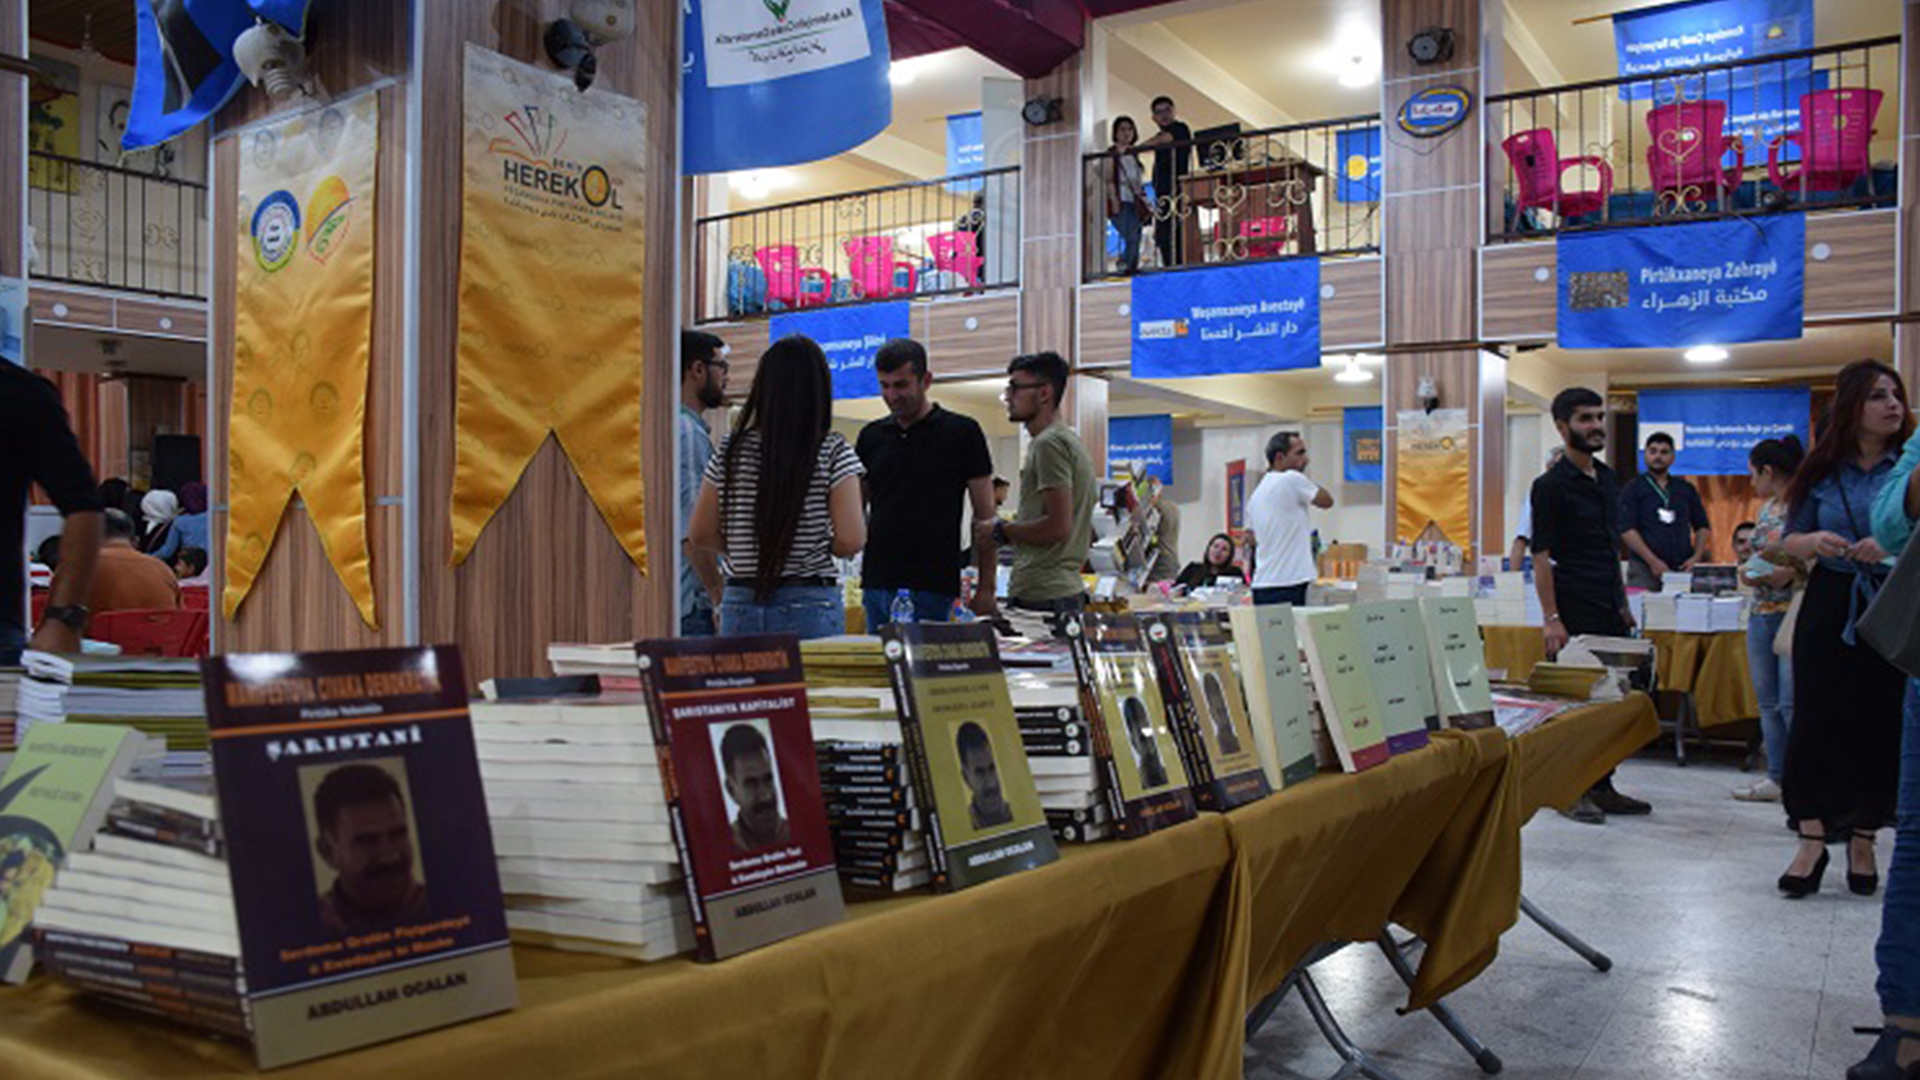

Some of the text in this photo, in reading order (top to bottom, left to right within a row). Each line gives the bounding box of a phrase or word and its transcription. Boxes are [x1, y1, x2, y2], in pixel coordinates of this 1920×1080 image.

[1641, 288, 1768, 313] مكتبة الزهراء
[1281, 321, 1298, 338] دار
[265, 723, 423, 762] ŞARISTANÎ
[306, 986, 399, 1020] ABDULLAH
